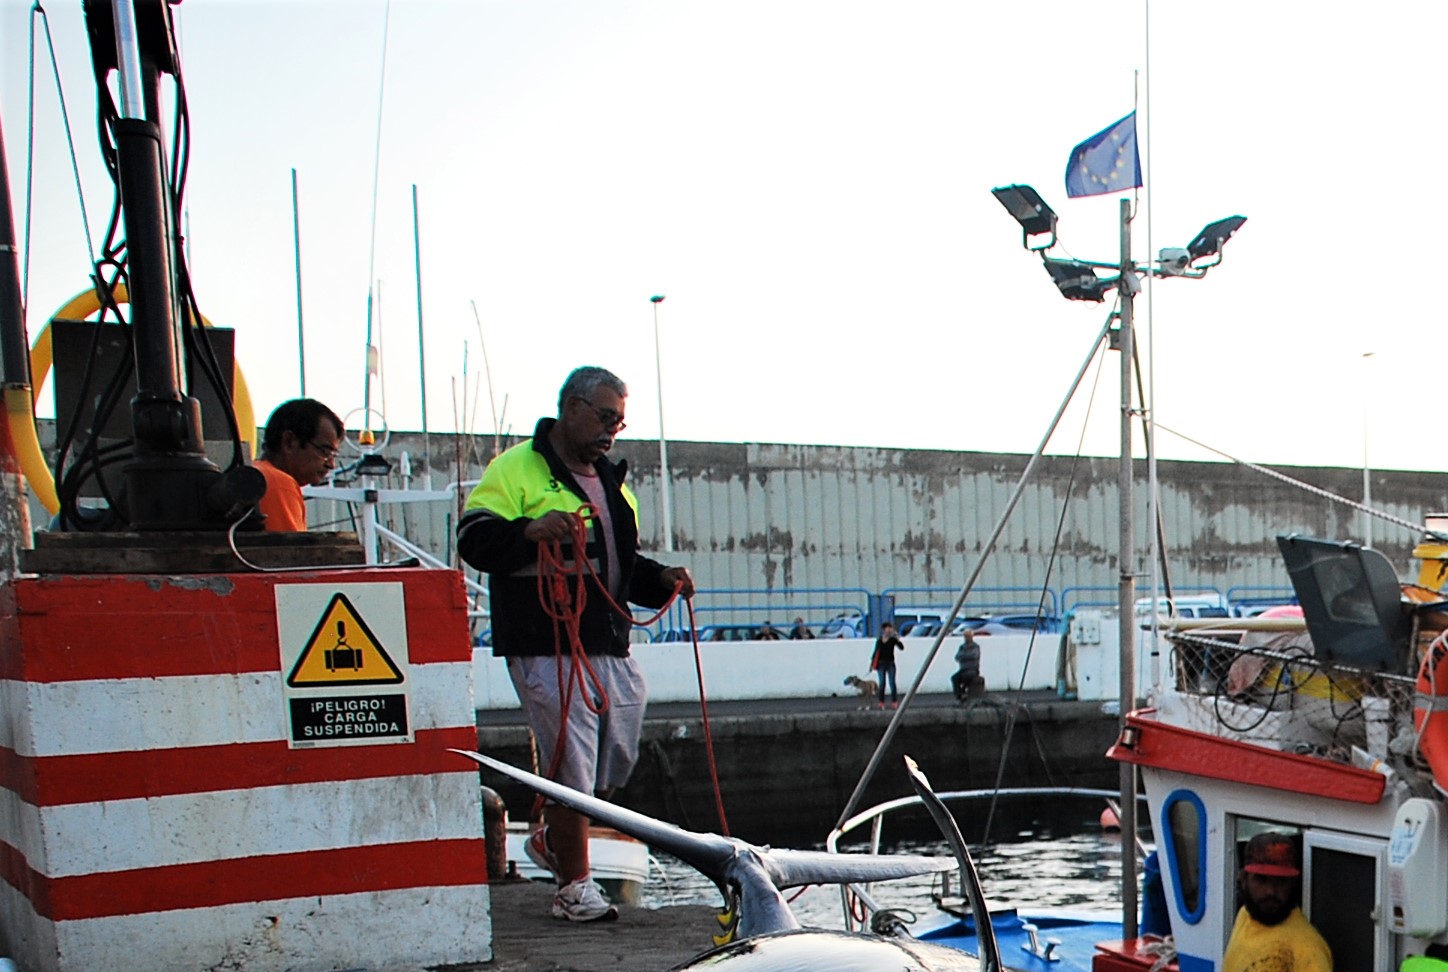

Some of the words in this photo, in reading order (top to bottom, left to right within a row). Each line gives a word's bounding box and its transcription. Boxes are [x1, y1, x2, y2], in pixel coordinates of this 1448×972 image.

[311, 699, 386, 713] ¡PELIGRO!
[324, 711, 377, 724] CARGA
[304, 722, 399, 736] SUSPENDIDA
